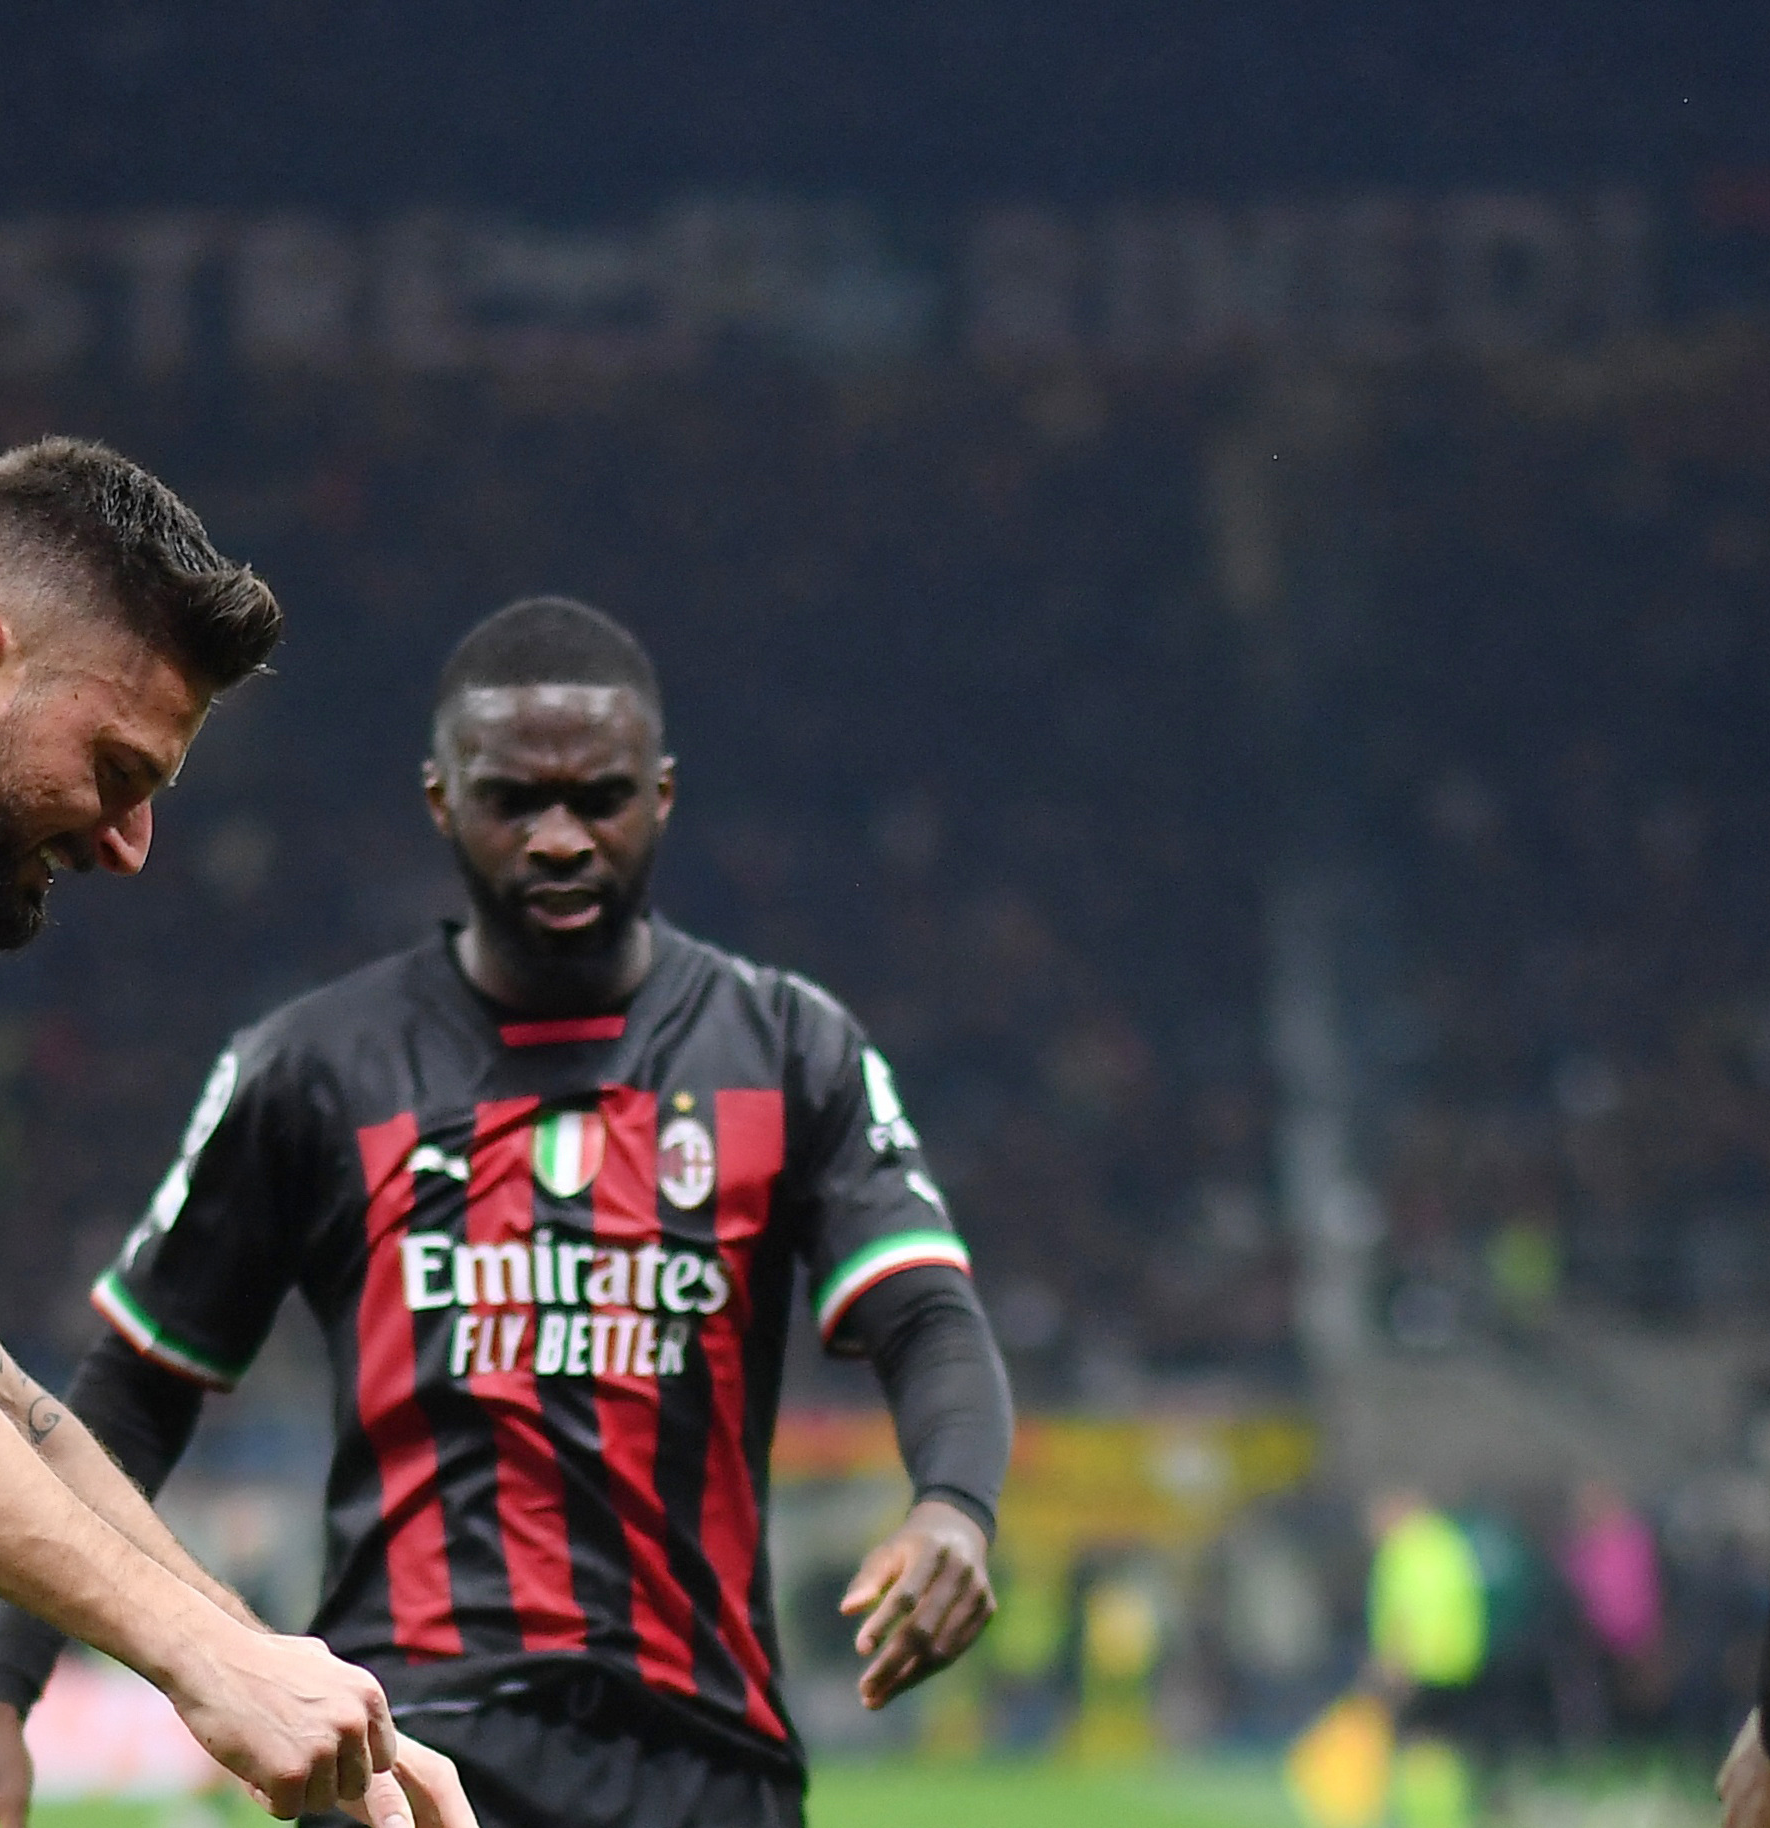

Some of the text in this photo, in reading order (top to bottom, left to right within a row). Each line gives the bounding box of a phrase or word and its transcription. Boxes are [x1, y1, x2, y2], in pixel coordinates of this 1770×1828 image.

[399, 1227, 732, 1316] Emirates
[449, 1314, 690, 1377] FLY BETTER
